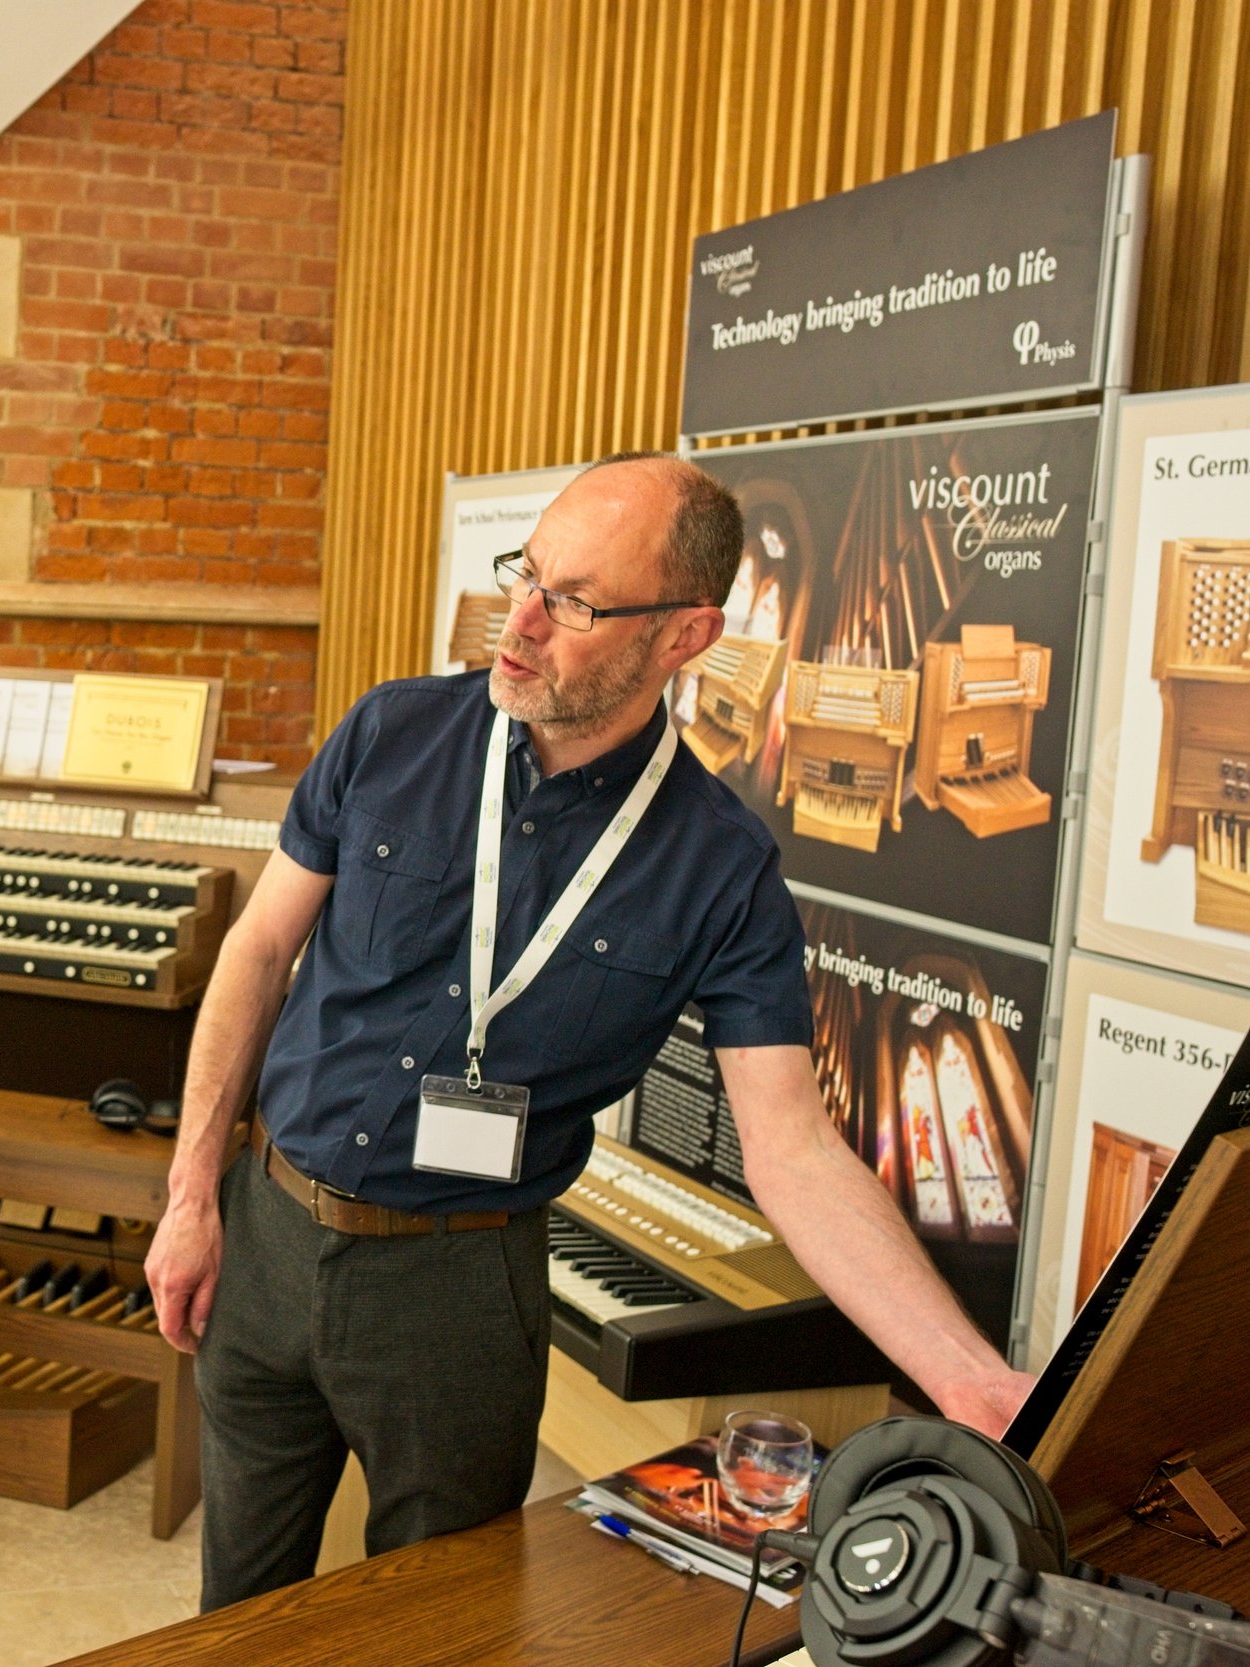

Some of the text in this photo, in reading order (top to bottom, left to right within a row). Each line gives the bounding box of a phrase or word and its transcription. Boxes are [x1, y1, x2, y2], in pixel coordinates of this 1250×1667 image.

[711, 247, 1057, 350] Technology bringing tradition to life
[1033, 339, 1076, 367] Physis
[909, 462, 1051, 510] viscount
[1154, 454, 1250, 480] St. Germ
[948, 495, 1068, 562] Classical
[984, 550, 1042, 579] organs
[818, 942, 885, 995] bringing
[887, 967, 962, 1013] tradition
[967, 991, 987, 1019] to
[991, 995, 1023, 1031] life
[1099, 1017, 1166, 1057] Regent
